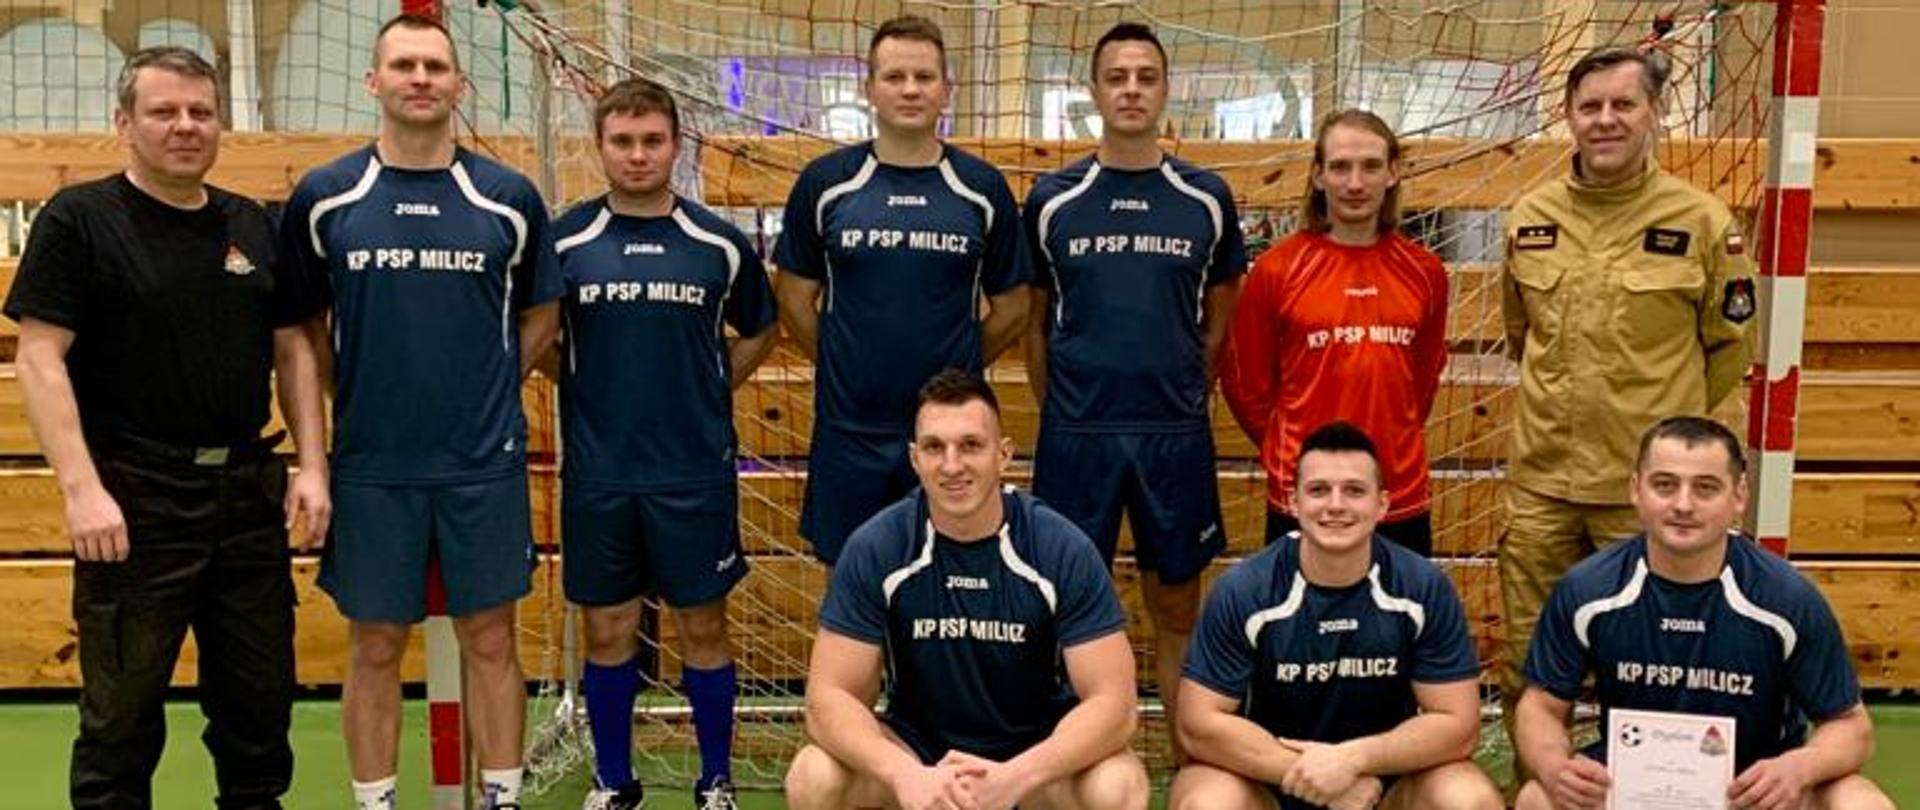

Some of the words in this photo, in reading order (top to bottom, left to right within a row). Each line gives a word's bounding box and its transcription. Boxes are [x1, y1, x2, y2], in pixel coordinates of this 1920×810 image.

[841, 229, 863, 247] KP
[868, 229, 903, 248] PSP
[909, 231, 969, 254] MILICZ
[1069, 237, 1091, 257] KP
[1096, 235, 1129, 253] PSP
[1134, 235, 1192, 257] MILICZ
[347, 250, 371, 271] KP
[376, 249, 415, 269] PSP
[419, 250, 486, 272] MILICZ
[579, 284, 600, 304] KP
[606, 282, 642, 301] PSP
[647, 282, 706, 305] MILICZ
[1334, 326, 1366, 343] PSP
[913, 618, 937, 639] KP
[1277, 662, 1302, 682] KP
[1338, 657, 1398, 678] MILICZ
[1616, 661, 1644, 683] KP
[1645, 664, 1684, 687] PSP
[1687, 668, 1755, 696] MILICZ
